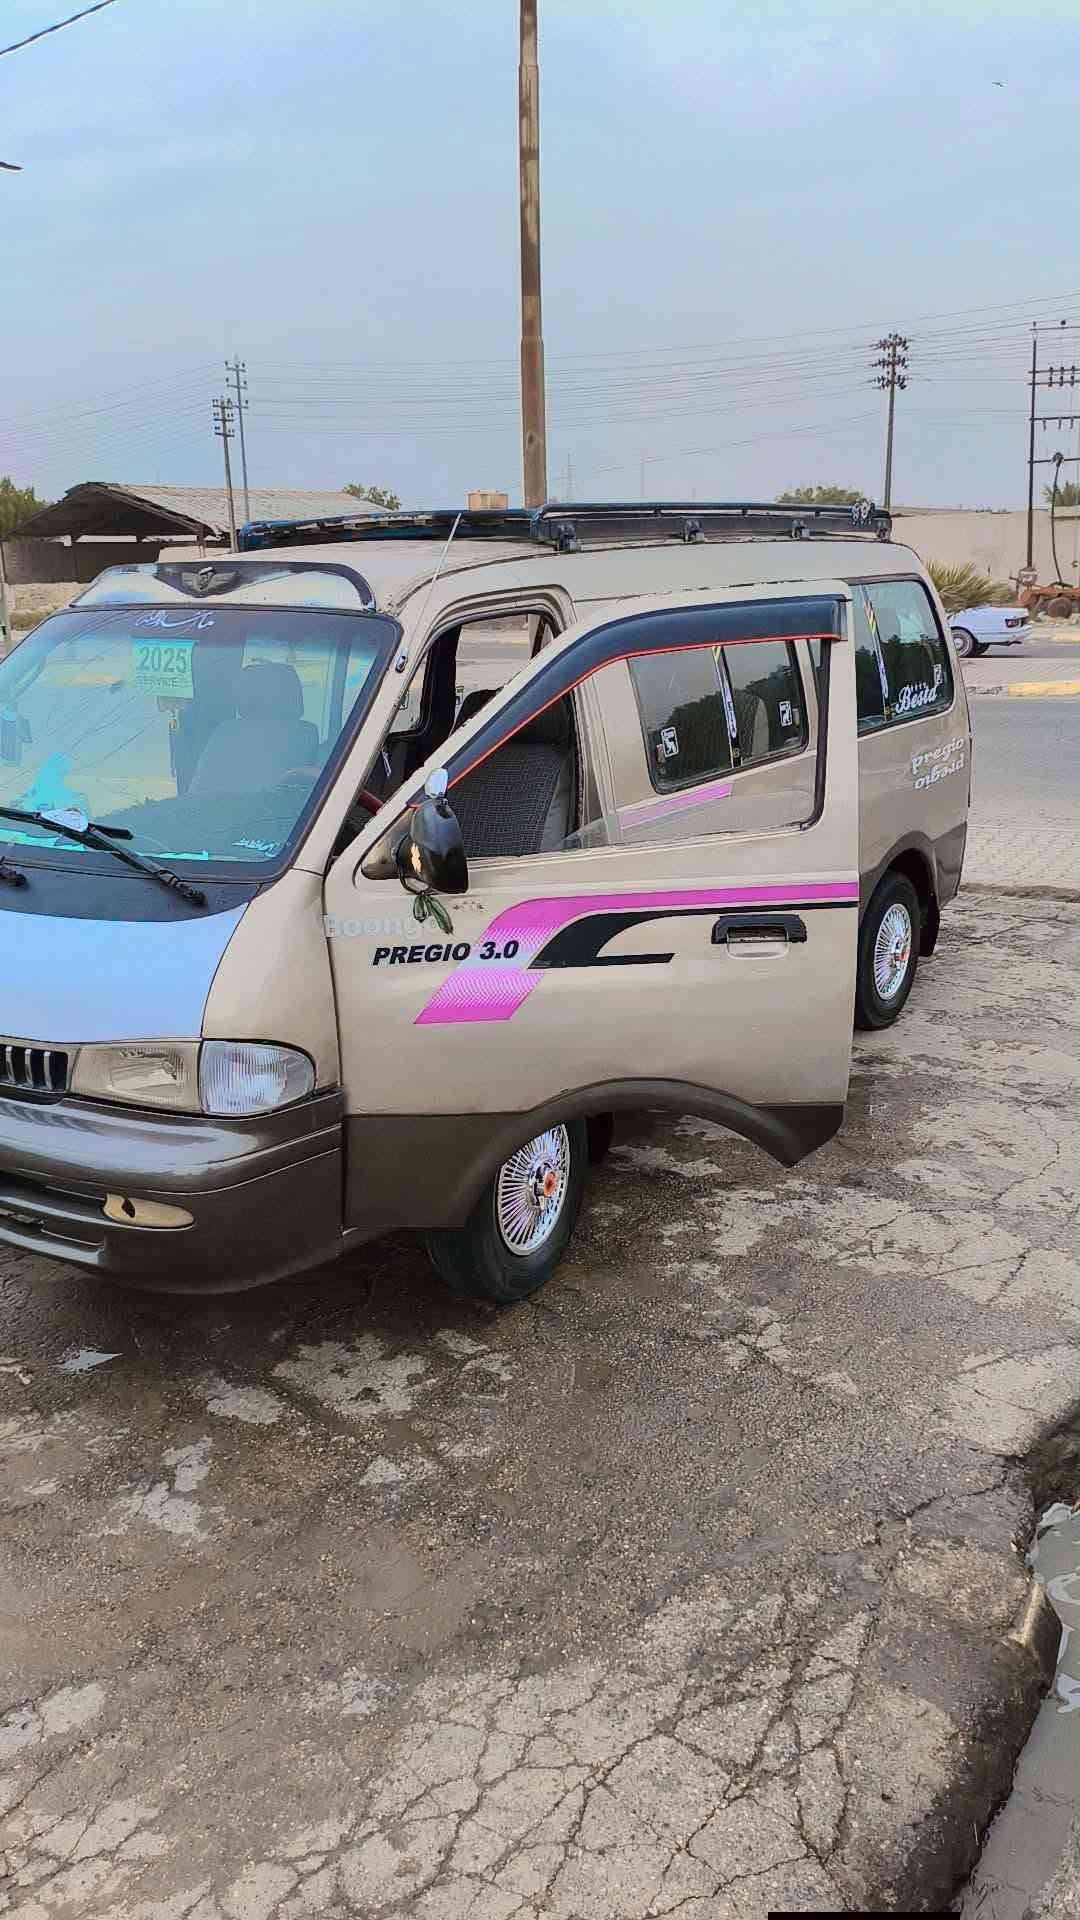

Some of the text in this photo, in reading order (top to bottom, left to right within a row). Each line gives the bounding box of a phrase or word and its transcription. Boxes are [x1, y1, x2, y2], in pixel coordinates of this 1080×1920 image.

[137, 646, 188, 674] 2025
[911, 738, 965, 775] Pregio
[372, 940, 519, 966] PREGIO 3.0
